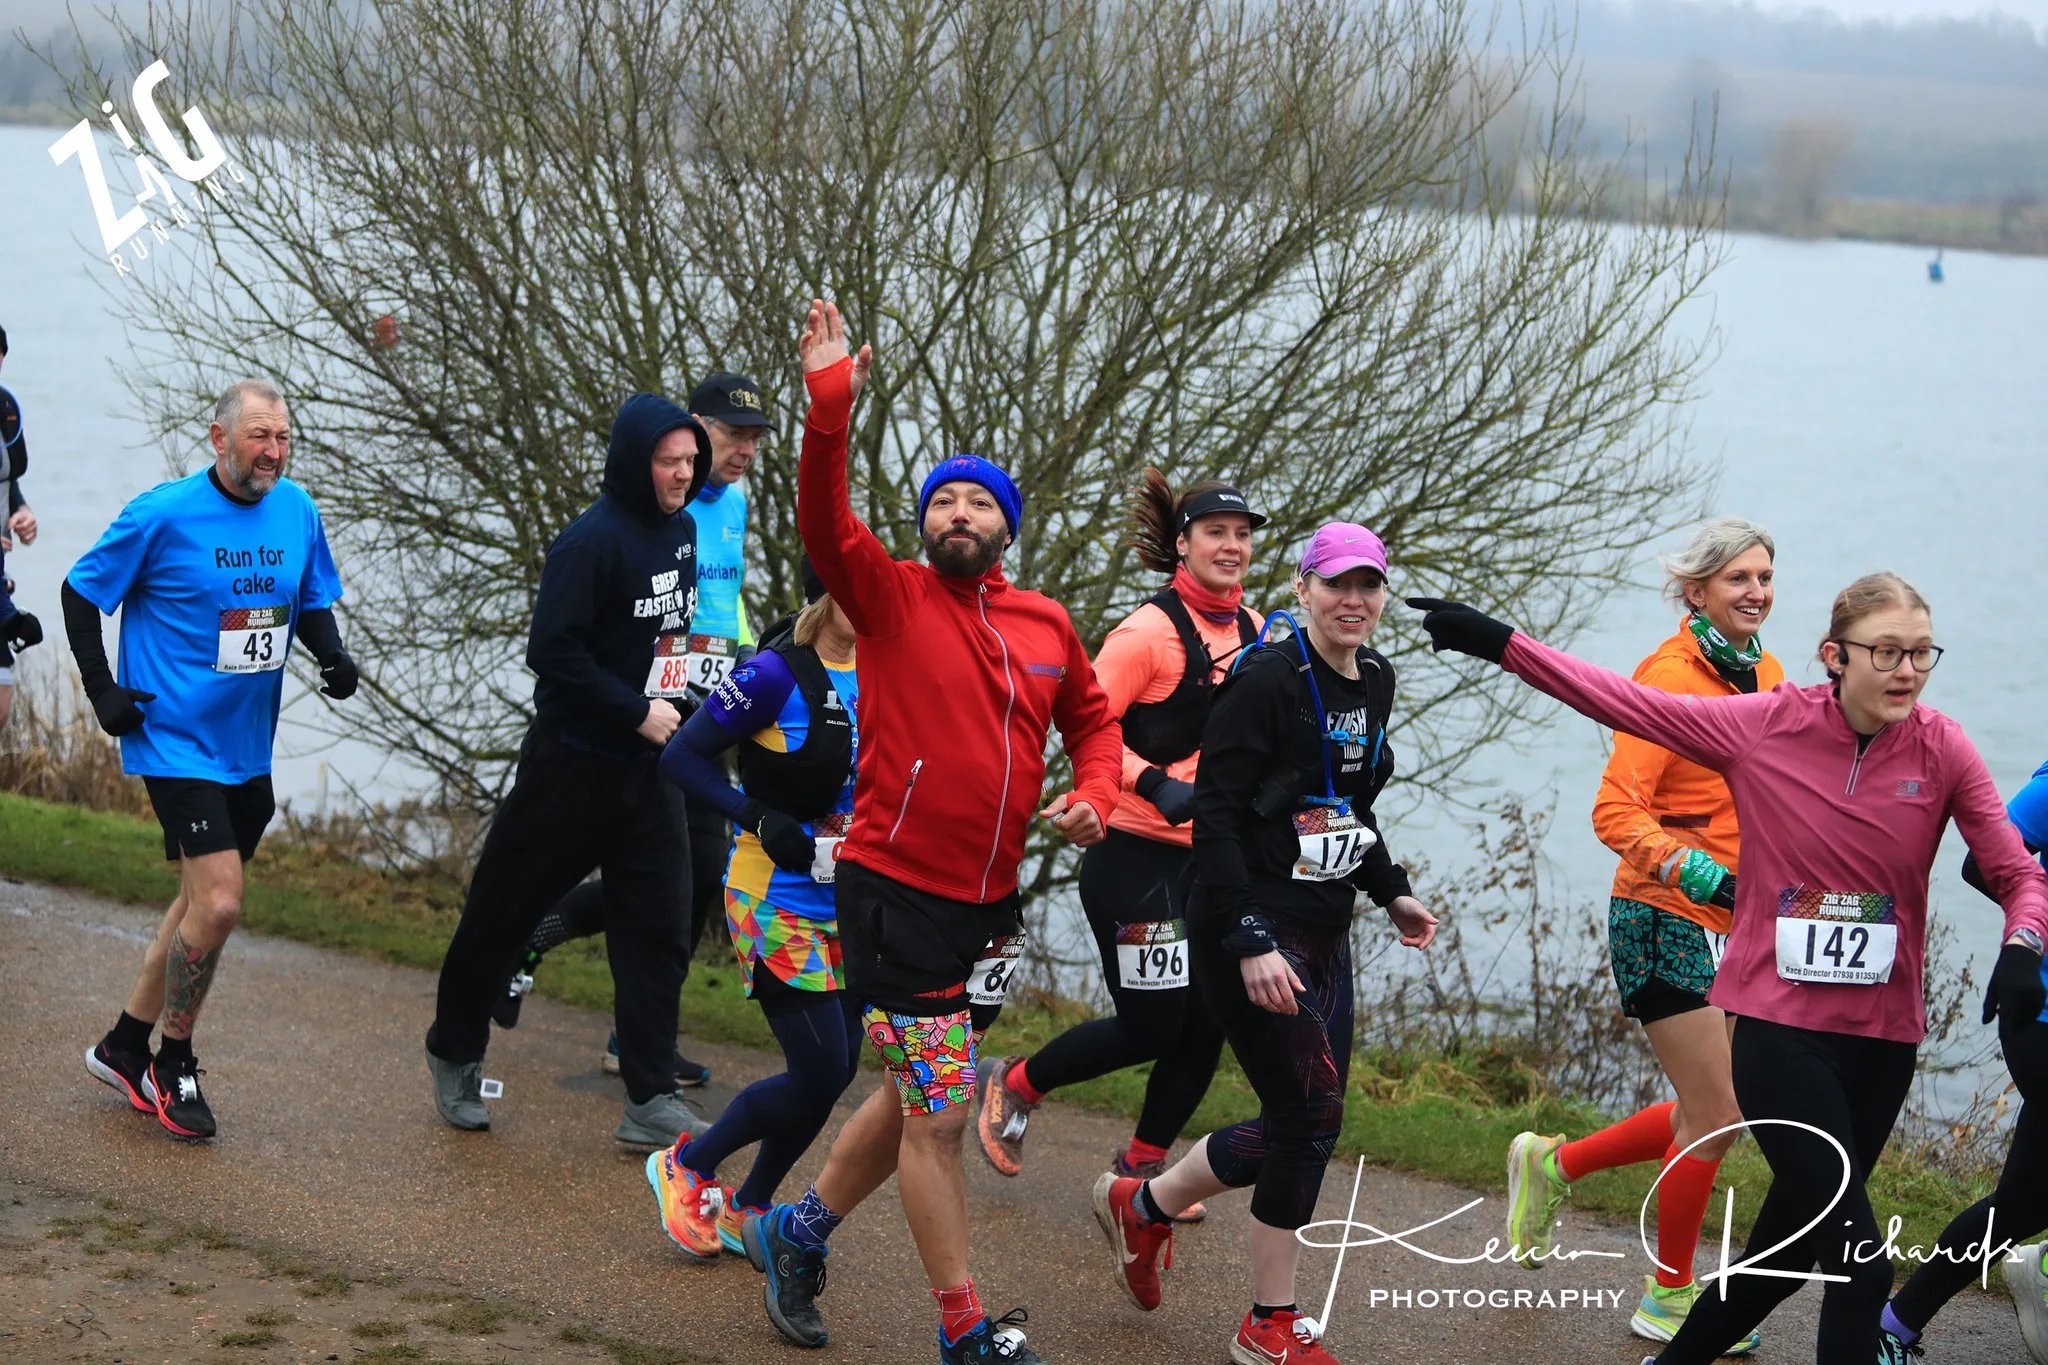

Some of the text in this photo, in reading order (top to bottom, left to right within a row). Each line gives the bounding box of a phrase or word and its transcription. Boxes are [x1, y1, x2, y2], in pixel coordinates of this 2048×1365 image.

[215, 545, 285, 568] Run for
[232, 573, 275, 595] cake
[651, 570, 679, 595] GREAT
[698, 563, 738, 580] Adrian
[243, 631, 273, 662] 43
[660, 659, 688, 689] 885
[700, 657, 725, 686] 95
[1320, 832, 1363, 871] 176
[1819, 904, 1863, 918] RUNNING
[1822, 893, 1860, 907] ZIG ZAG
[1805, 923, 1870, 969] 142
[1136, 945, 1183, 978] 196
[1785, 966, 1802, 976] Race
[1803, 968, 1831, 977] Director
[1832, 970, 1854, 980] 07930
[664, 1150, 675, 1181] HOKA
